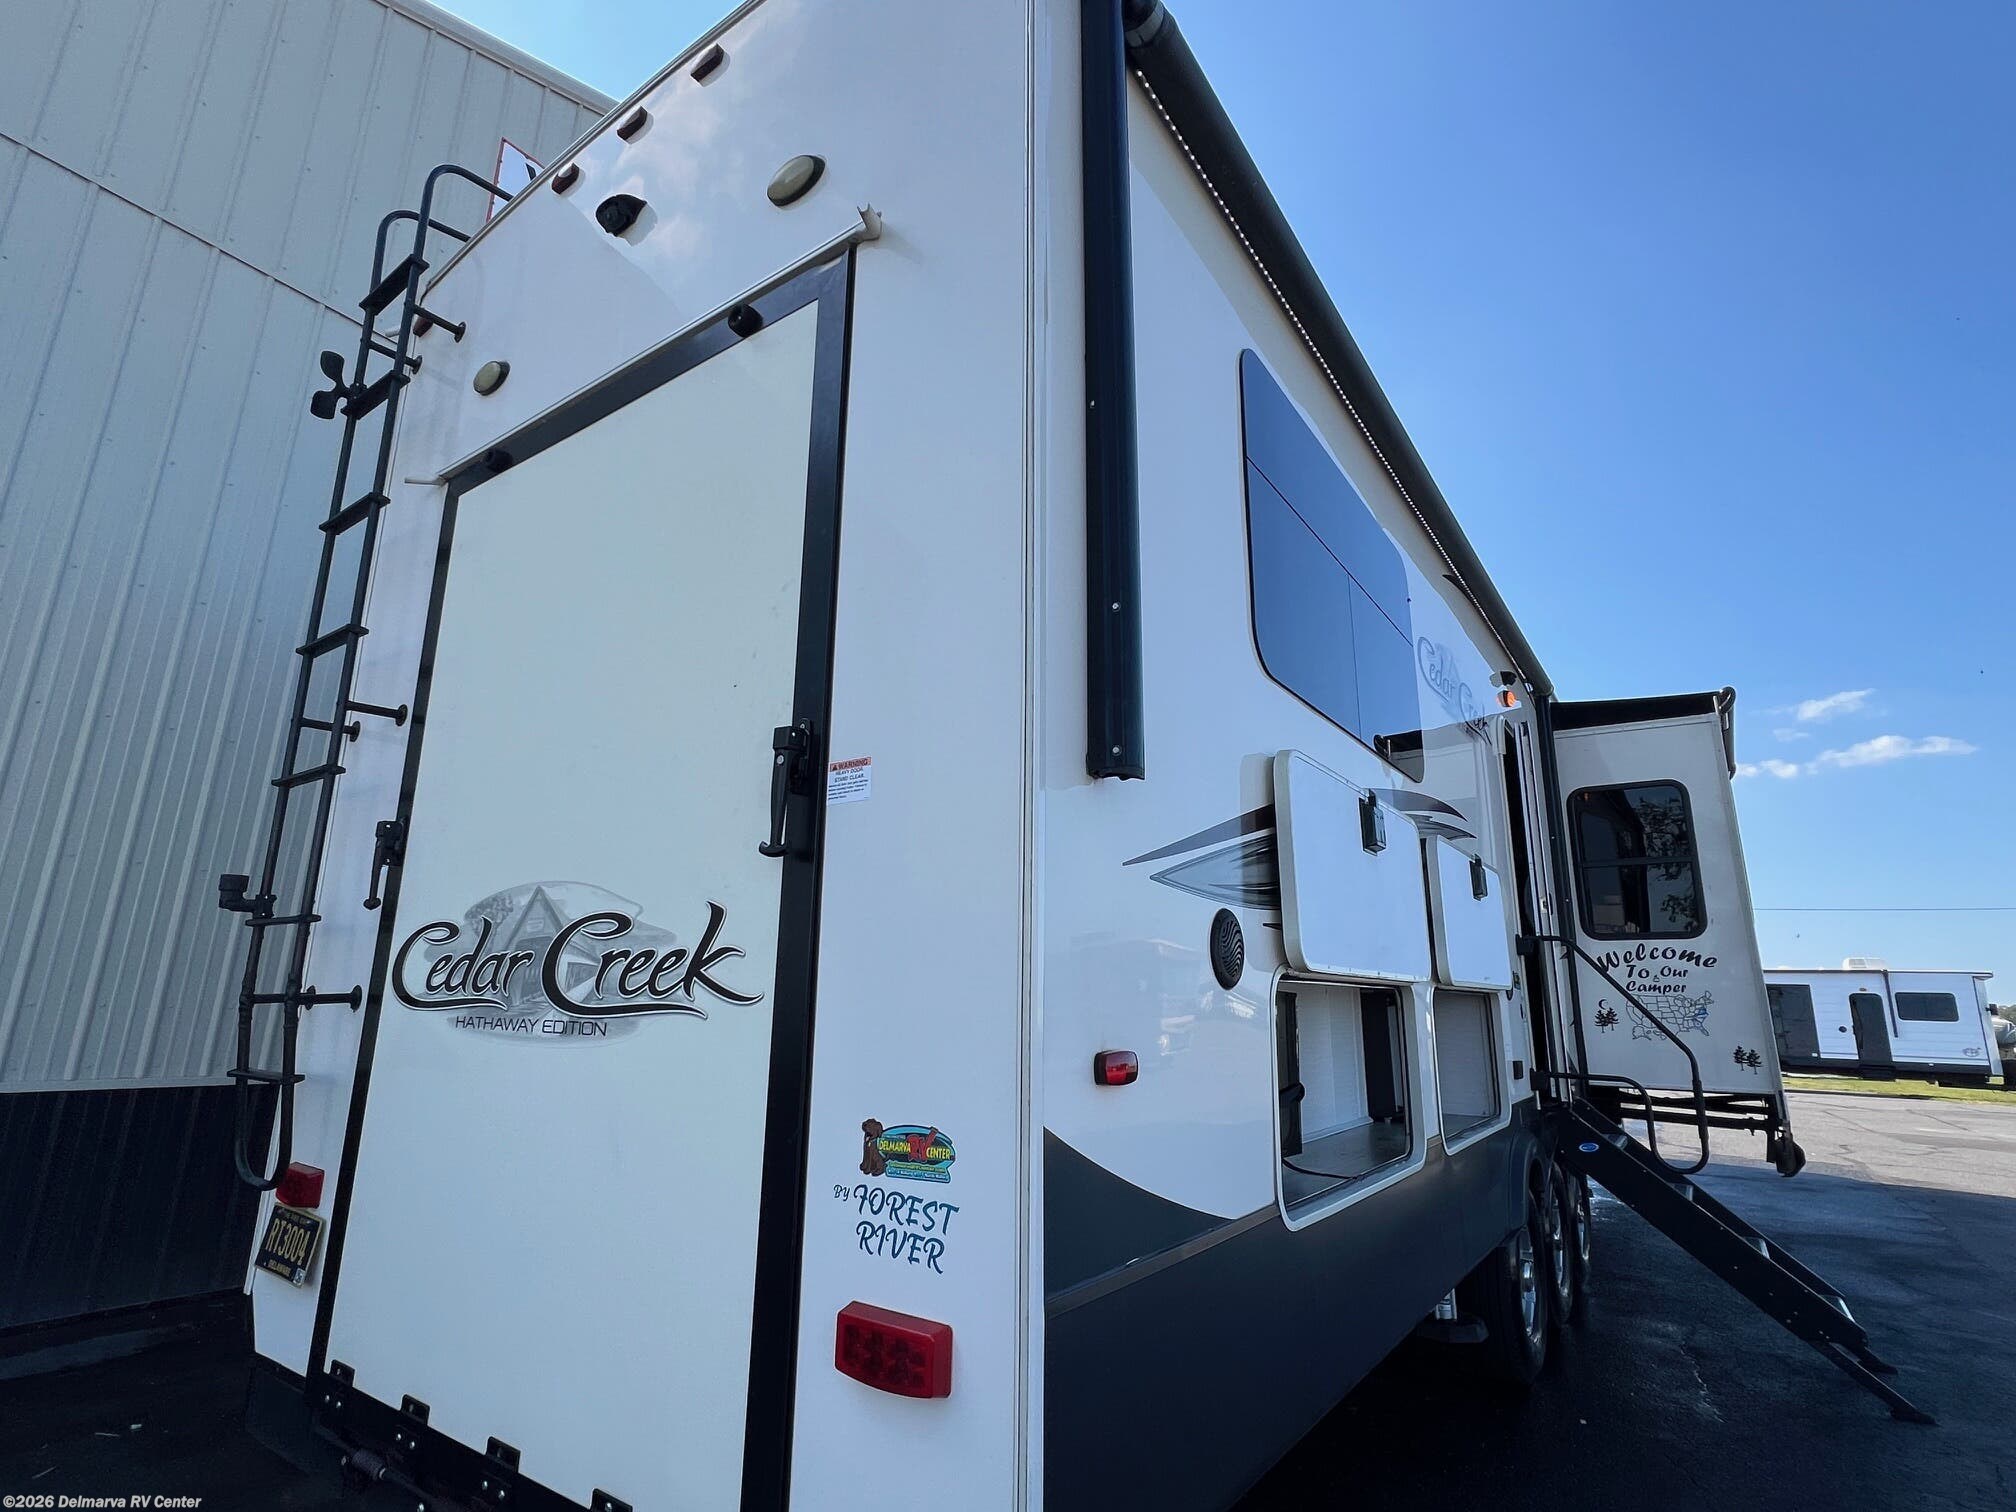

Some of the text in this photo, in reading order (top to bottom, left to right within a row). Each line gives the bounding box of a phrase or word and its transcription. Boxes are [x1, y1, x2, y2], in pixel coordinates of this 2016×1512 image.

[1417, 636, 1456, 704] Cedar
[837, 757, 868, 770] WARNING
[849, 773, 864, 781] CLEAR
[392, 900, 764, 1019] Cedar Creek
[1596, 942, 1718, 973] Welcome
[1626, 964, 1689, 979] To Our
[1625, 980, 1687, 995] Camper
[456, 1016, 607, 1036] HATHAWAY EDITION
[879, 1140, 911, 1153] DELMARVA
[907, 1129, 938, 1162] RV
[925, 1146, 951, 1160] CENTER
[853, 1184, 960, 1235] FOREST
[265, 1217, 311, 1266] RT3004
[856, 1220, 944, 1274] RIVER
